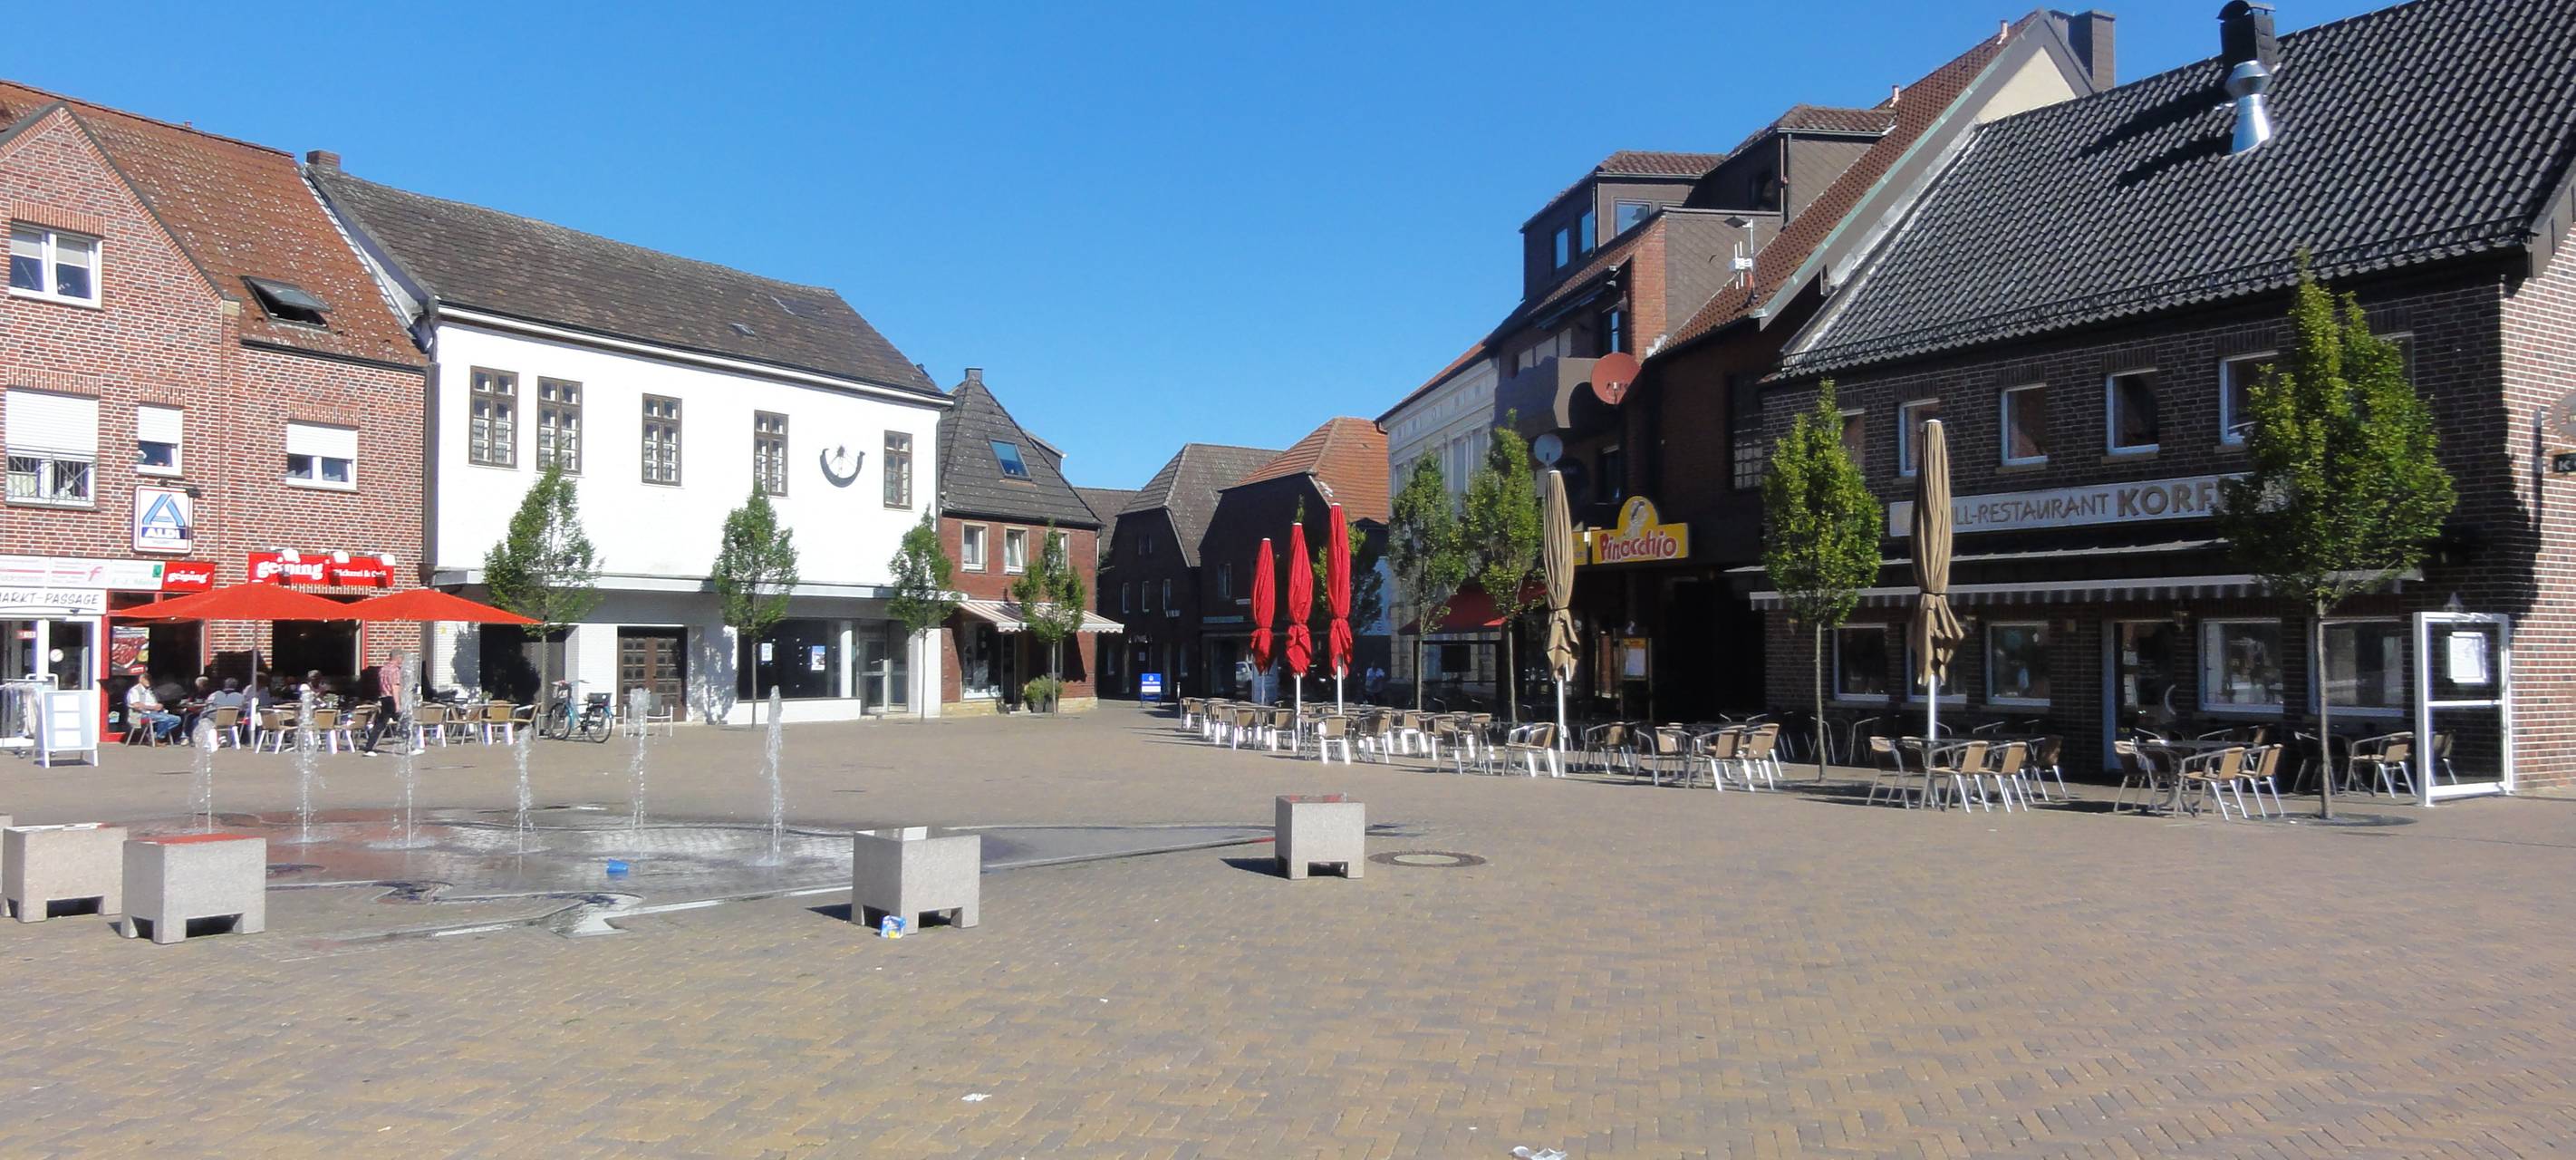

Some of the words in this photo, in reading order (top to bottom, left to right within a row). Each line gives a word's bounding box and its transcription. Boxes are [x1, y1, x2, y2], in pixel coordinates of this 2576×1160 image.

[2558, 460, 2576, 471] K
[1951, 493, 2109, 526] ILL-RESTAURANT
[145, 527, 181, 539] ALDI
[1599, 530, 1677, 562] Pinocchio
[0, 592, 100, 604] ARKT-PASSAGE
